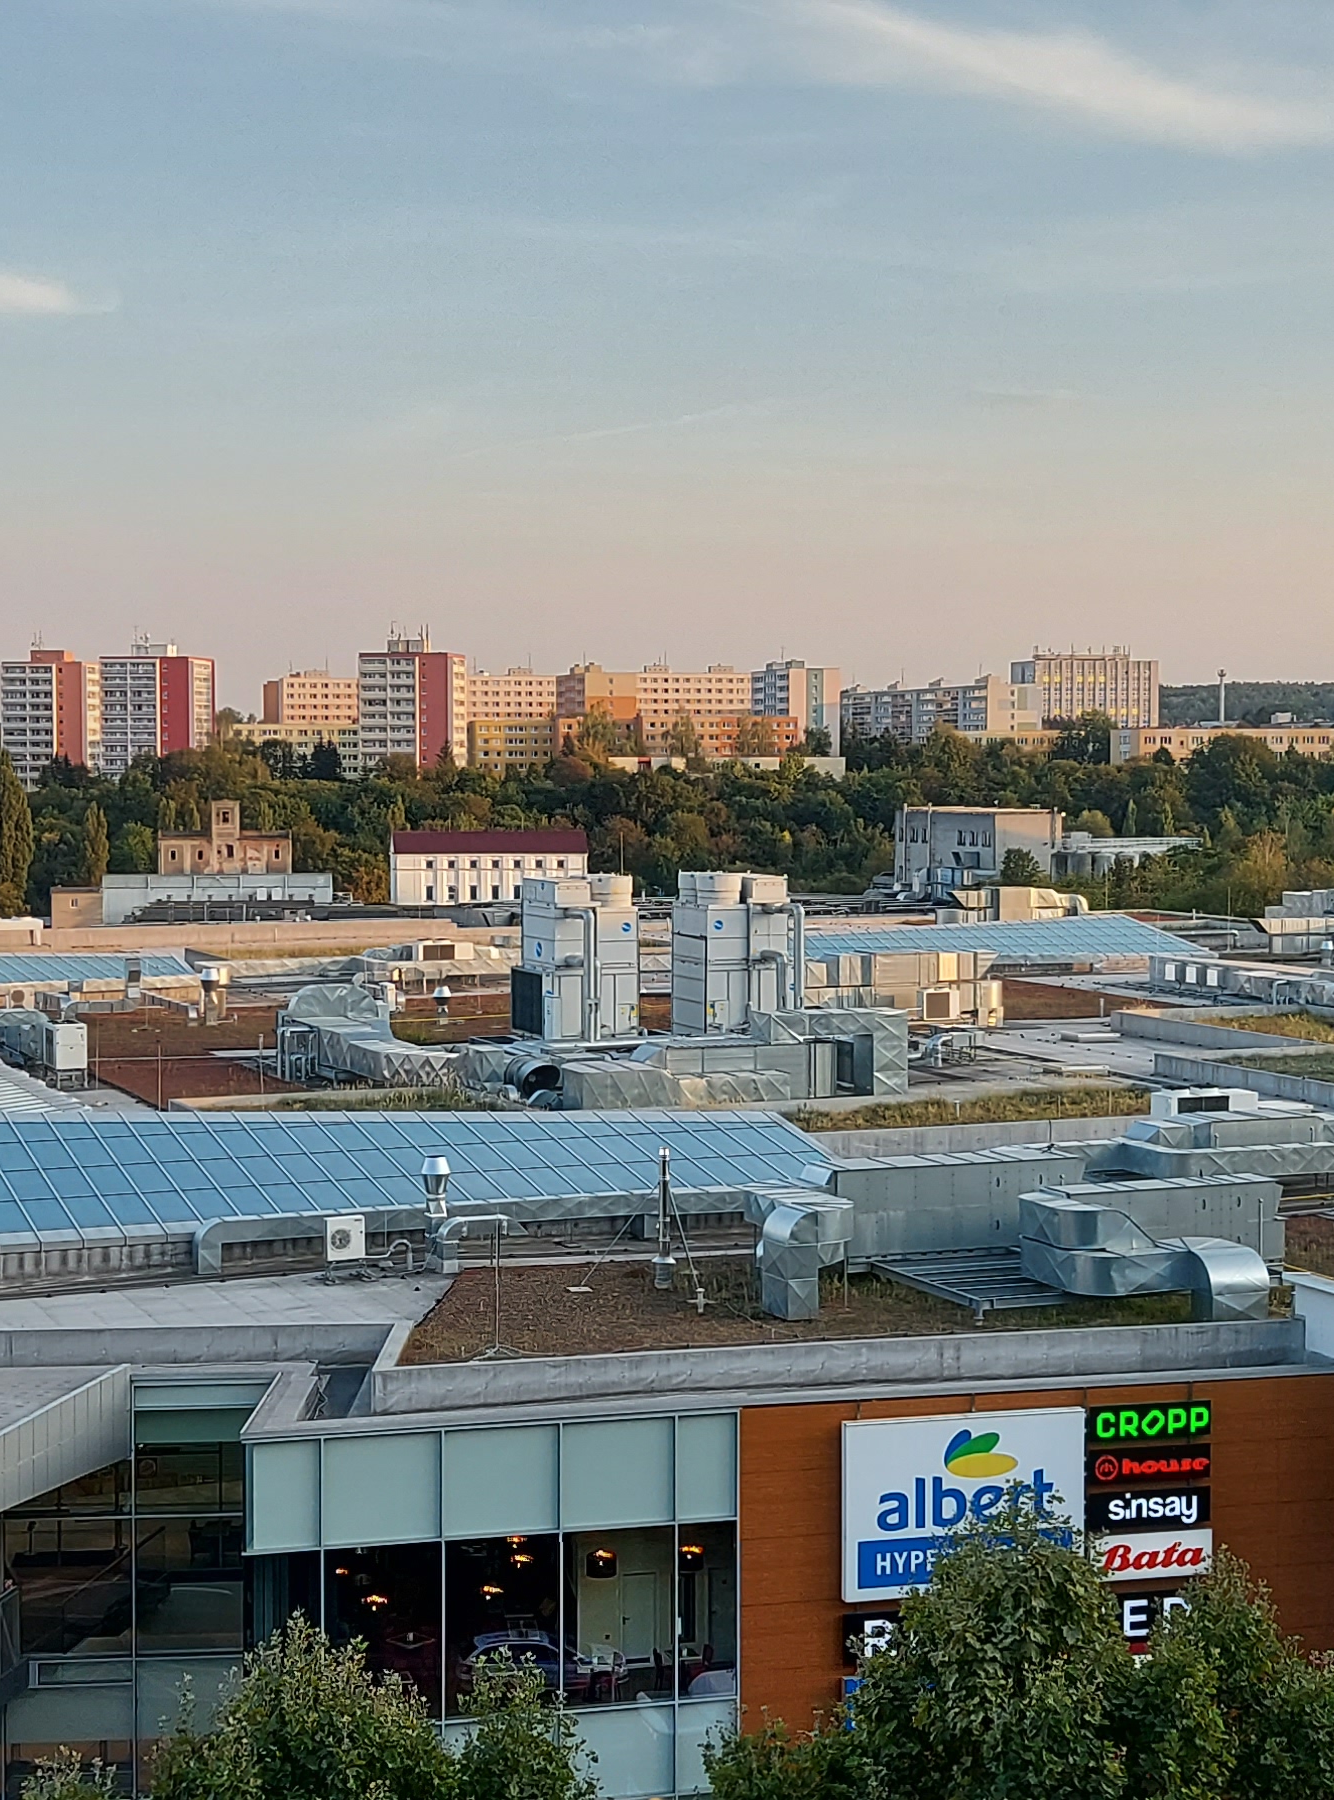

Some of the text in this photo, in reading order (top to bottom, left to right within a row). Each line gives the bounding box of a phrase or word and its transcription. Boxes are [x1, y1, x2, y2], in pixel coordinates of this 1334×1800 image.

[1096, 1407, 1209, 1438] CROPP
[1122, 1458, 1210, 1474] house
[877, 1468, 1054, 1532] albert
[1108, 1493, 1198, 1524] sinsay
